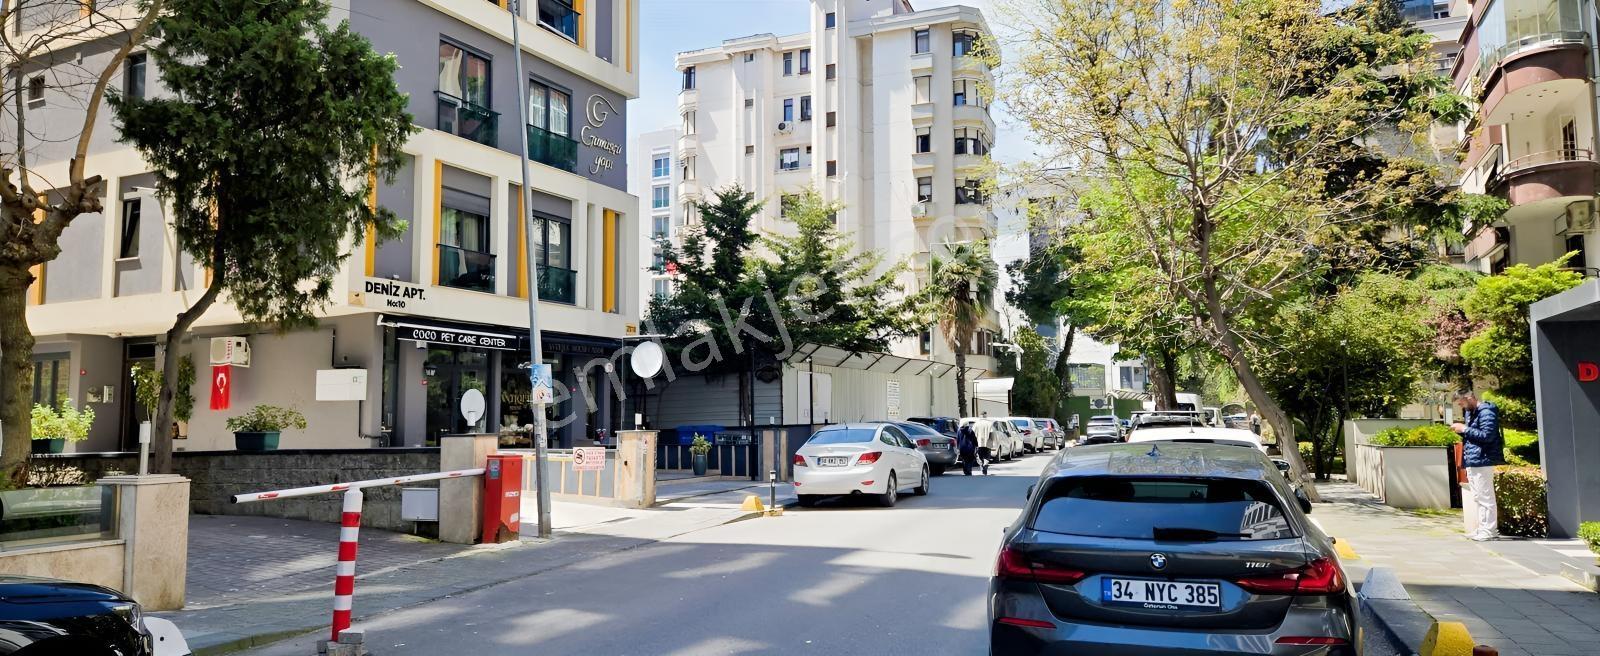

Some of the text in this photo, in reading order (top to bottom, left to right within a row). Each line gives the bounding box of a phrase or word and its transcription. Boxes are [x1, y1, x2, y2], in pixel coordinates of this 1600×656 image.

[365, 281, 426, 300] DENİZ APT.
[412, 329, 506, 347] COCO PET CARE CENTER
[1112, 581, 1134, 600] 34
[1145, 582, 1178, 602] NYC
[1184, 585, 1218, 605] 385
